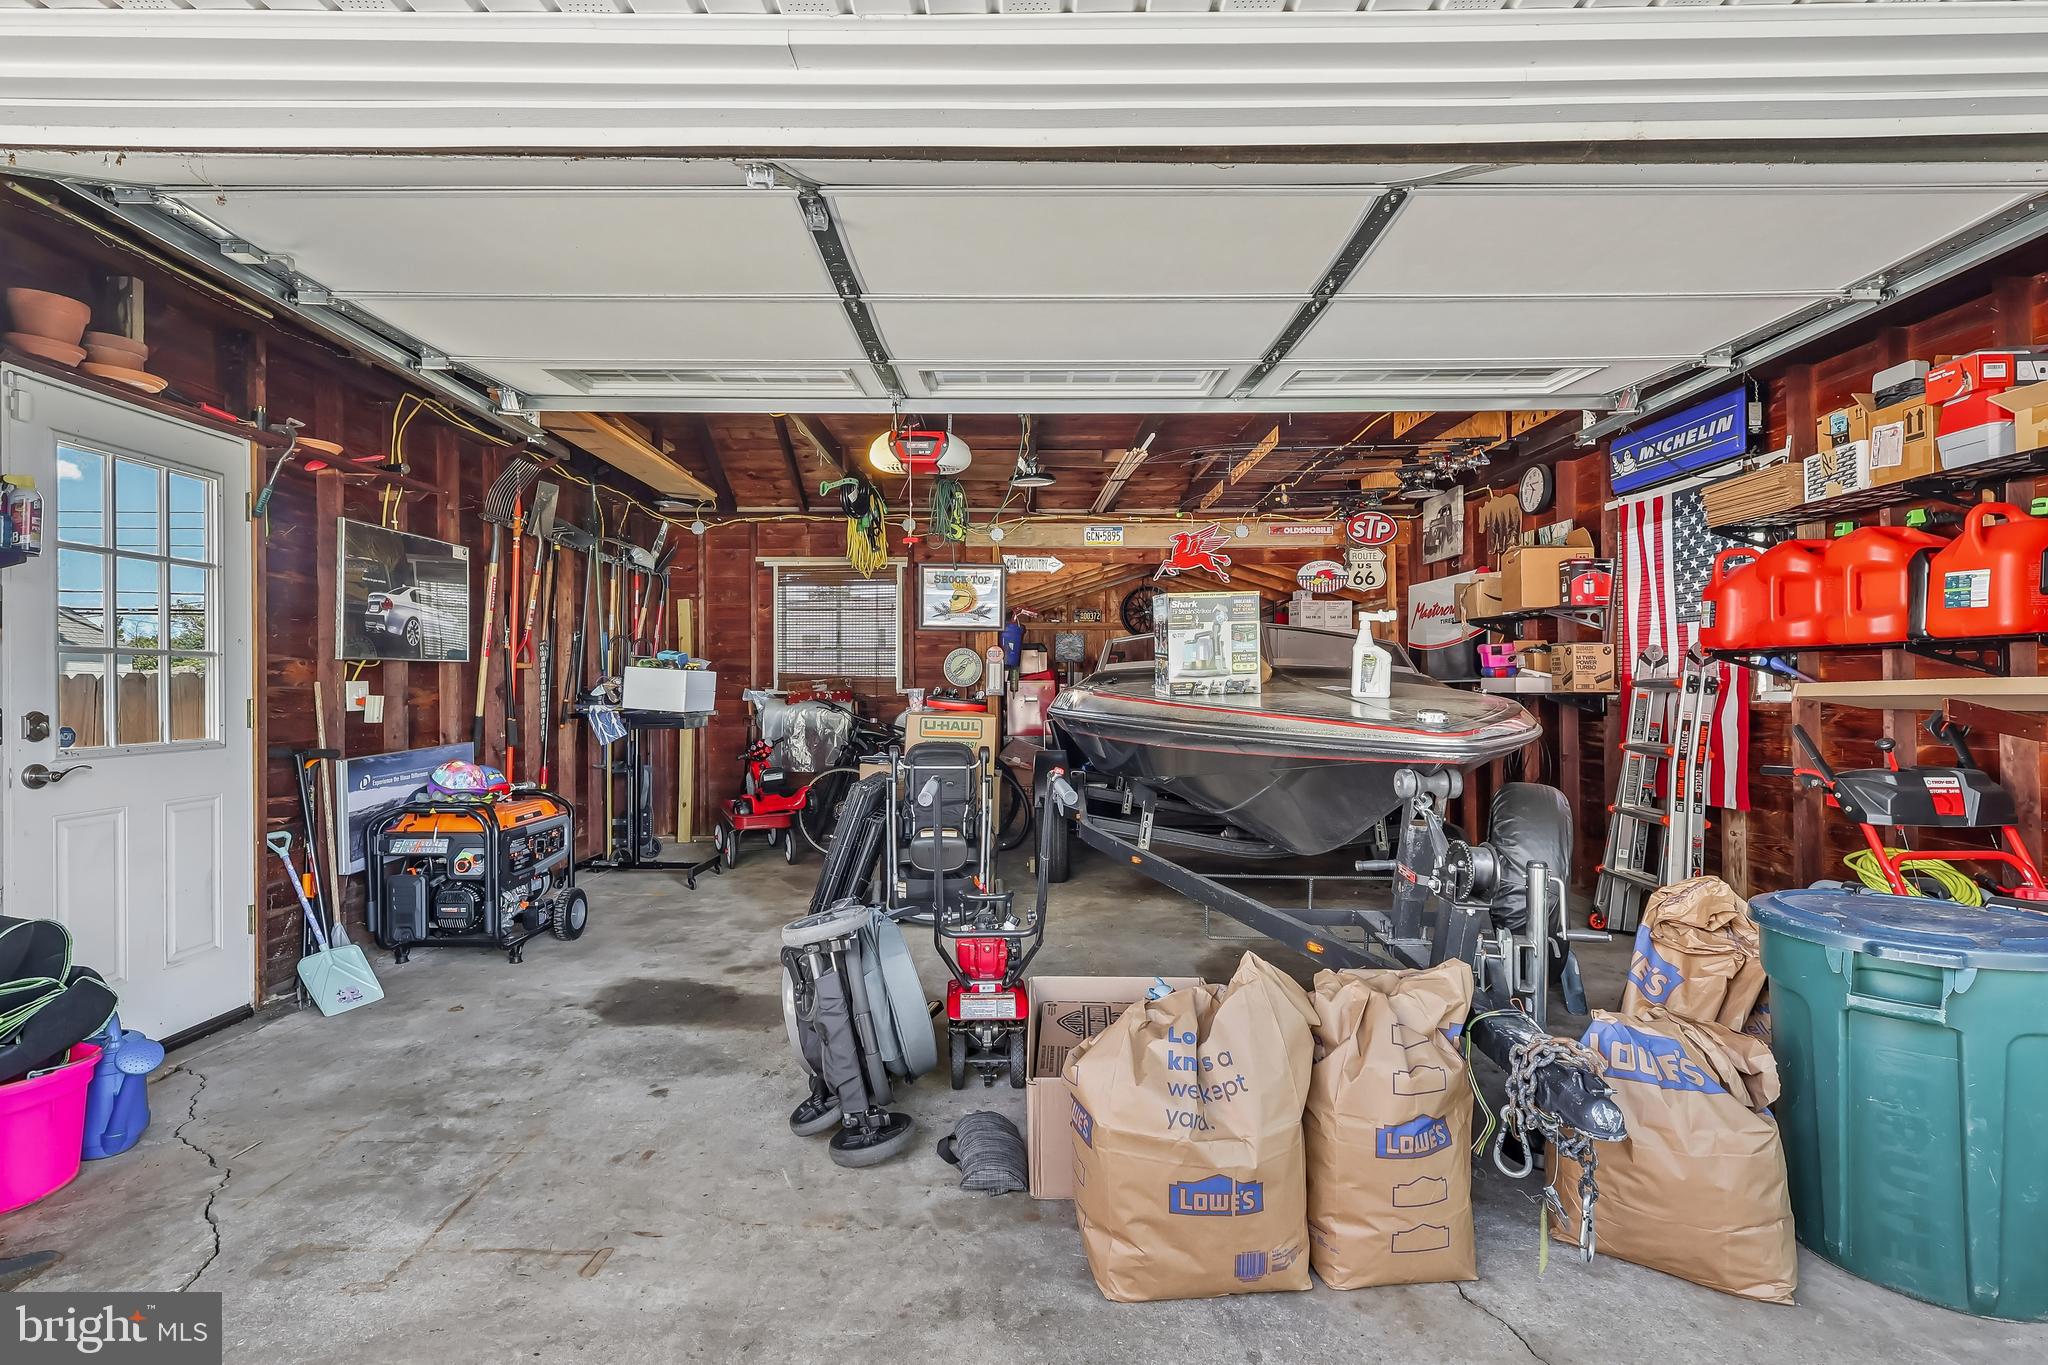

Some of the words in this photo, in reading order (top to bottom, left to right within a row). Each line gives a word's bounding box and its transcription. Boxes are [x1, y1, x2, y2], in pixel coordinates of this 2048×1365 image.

[1638, 413, 1734, 462] MICHELIN
[1283, 526, 1333, 535] OLDSMOBILE
[1352, 515, 1391, 540] STP
[1006, 558, 1024, 570] CHEVY
[1024, 559, 1049, 570] COUNTRY
[1352, 552, 1377, 560] ROUTE
[933, 574, 968, 585] SHOCK
[970, 574, 991, 585] TOP
[1353, 570, 1376, 586] 66
[1171, 600, 1199, 609] Shark
[1411, 601, 1456, 630] Mastercr
[1440, 617, 1455, 625] TIRES
[924, 720, 979, 731] U-HAUL
[1699, 724, 1709, 746] Little
[1697, 745, 1706, 764] Giant
[1678, 759, 1687, 778] Giant
[1676, 779, 1685, 799] Little
[1632, 951, 1669, 998] E'S
[1217, 1051, 1233, 1067] a
[1072, 1100, 1089, 1139] WE'S
[1386, 1122, 1447, 1154] LOWE'S
[1180, 1188, 1255, 1211] LOWE'S
